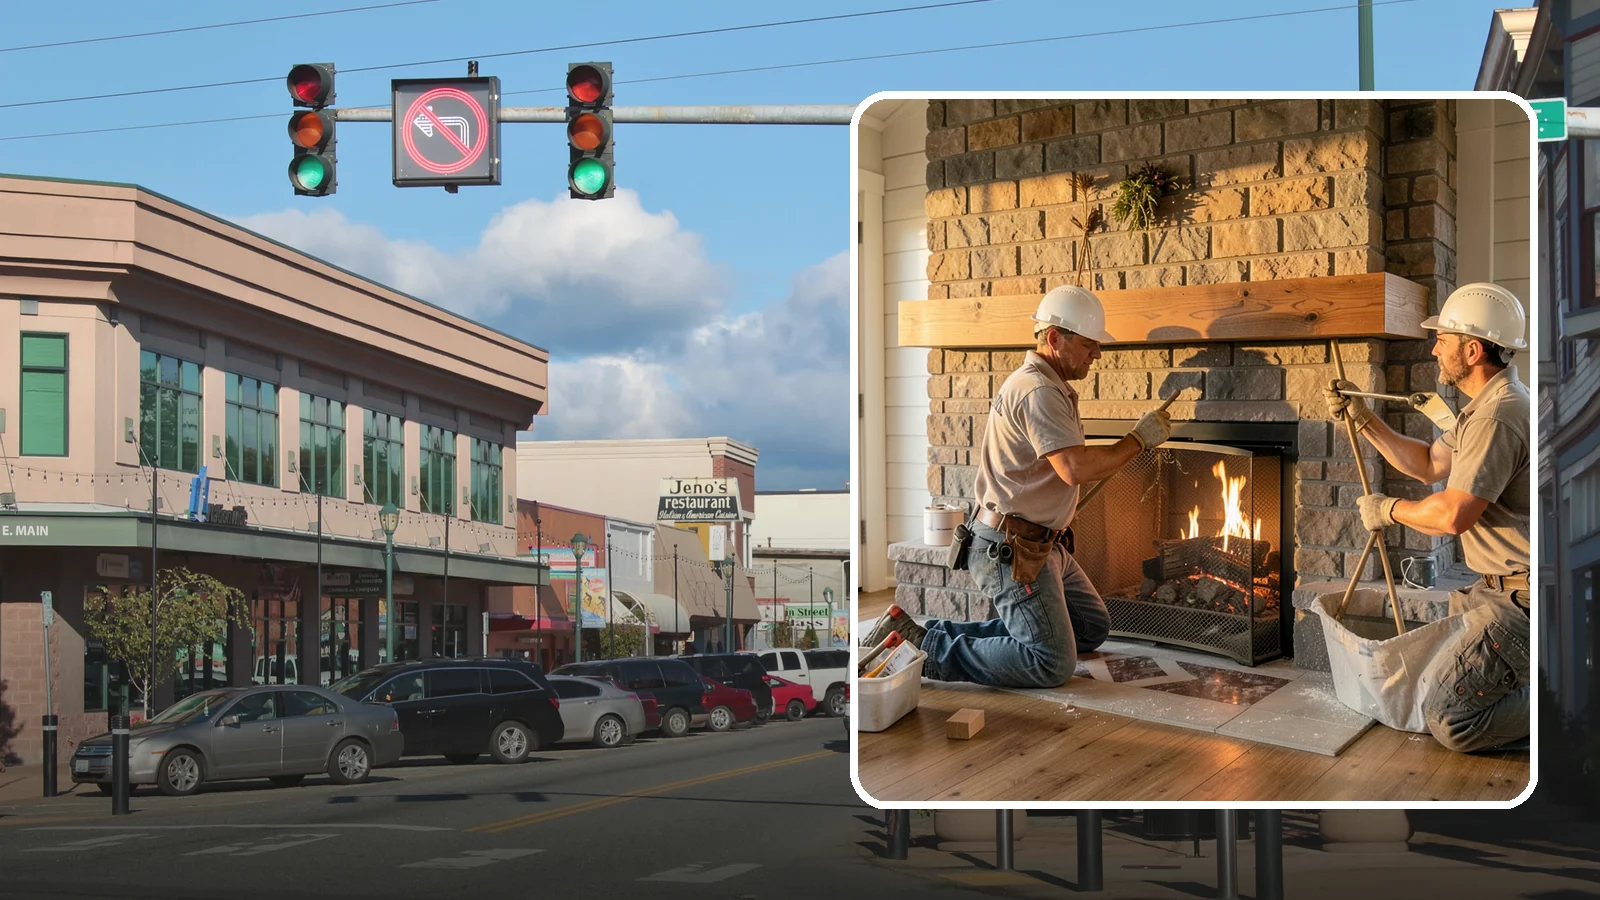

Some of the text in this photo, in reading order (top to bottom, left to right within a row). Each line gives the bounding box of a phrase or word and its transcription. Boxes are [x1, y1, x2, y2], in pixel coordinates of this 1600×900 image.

[670, 480, 727, 494] Jeno's
[665, 496, 730, 508] restaurant
[659, 510, 680, 519] Italian
[686, 510, 714, 518] American
[715, 510, 737, 518] Cuisine
[2, 525, 48, 536] E. MAIN
[798, 608, 828, 616] Street
